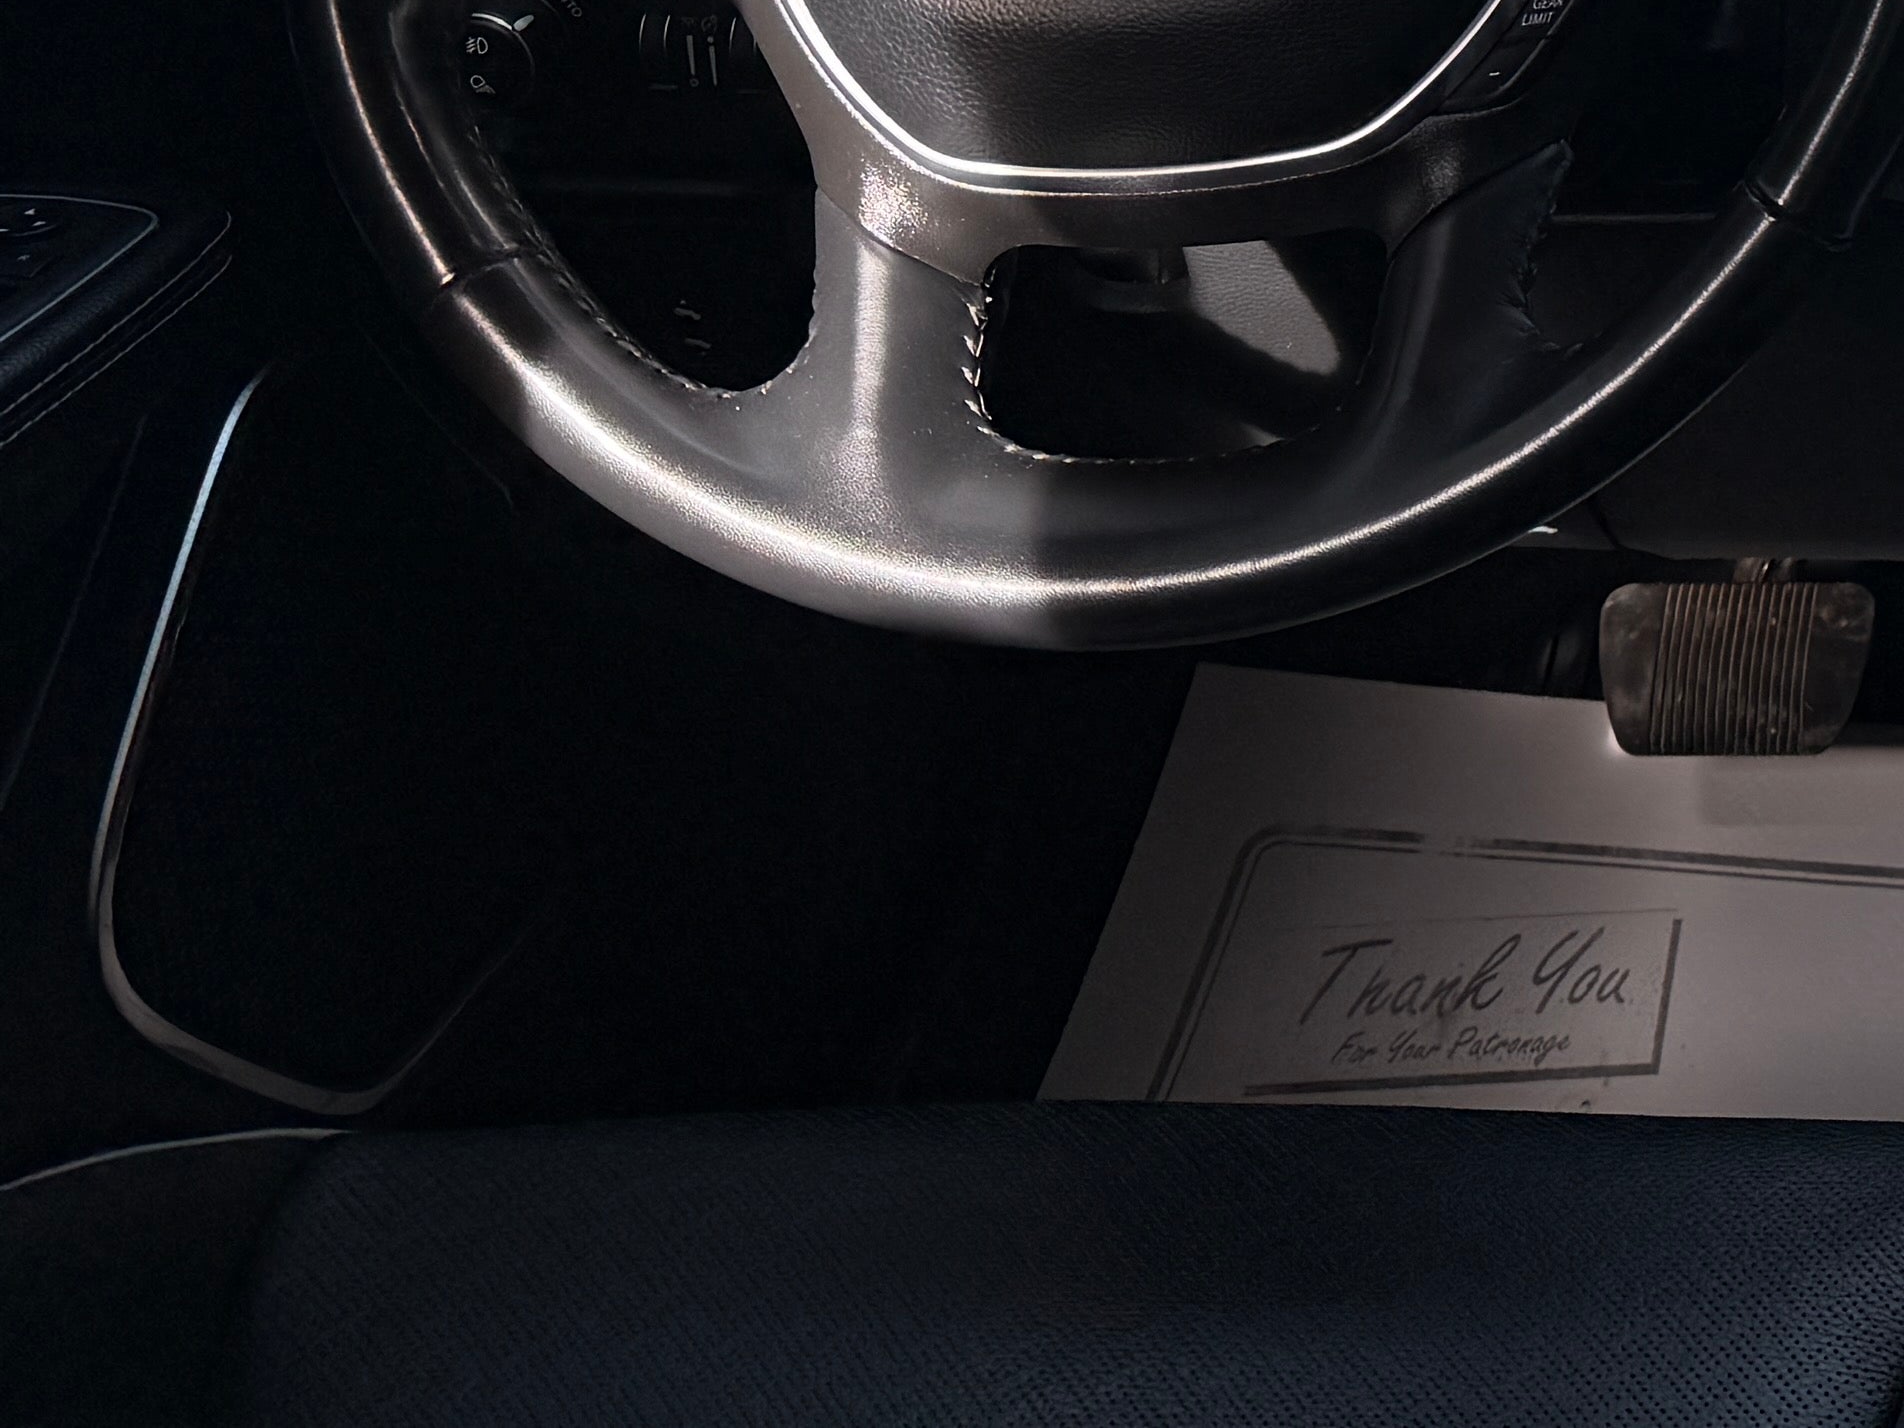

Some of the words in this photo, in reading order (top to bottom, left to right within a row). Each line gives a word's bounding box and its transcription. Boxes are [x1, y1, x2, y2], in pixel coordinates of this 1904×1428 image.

[1522, 12, 1555, 26] LIMIT
[1300, 933, 1522, 1025] Thank
[1532, 926, 1630, 1015] You
[1331, 1032, 1376, 1065] For
[1387, 1030, 1441, 1065] Your
[1448, 1026, 1572, 1067] Patronage
